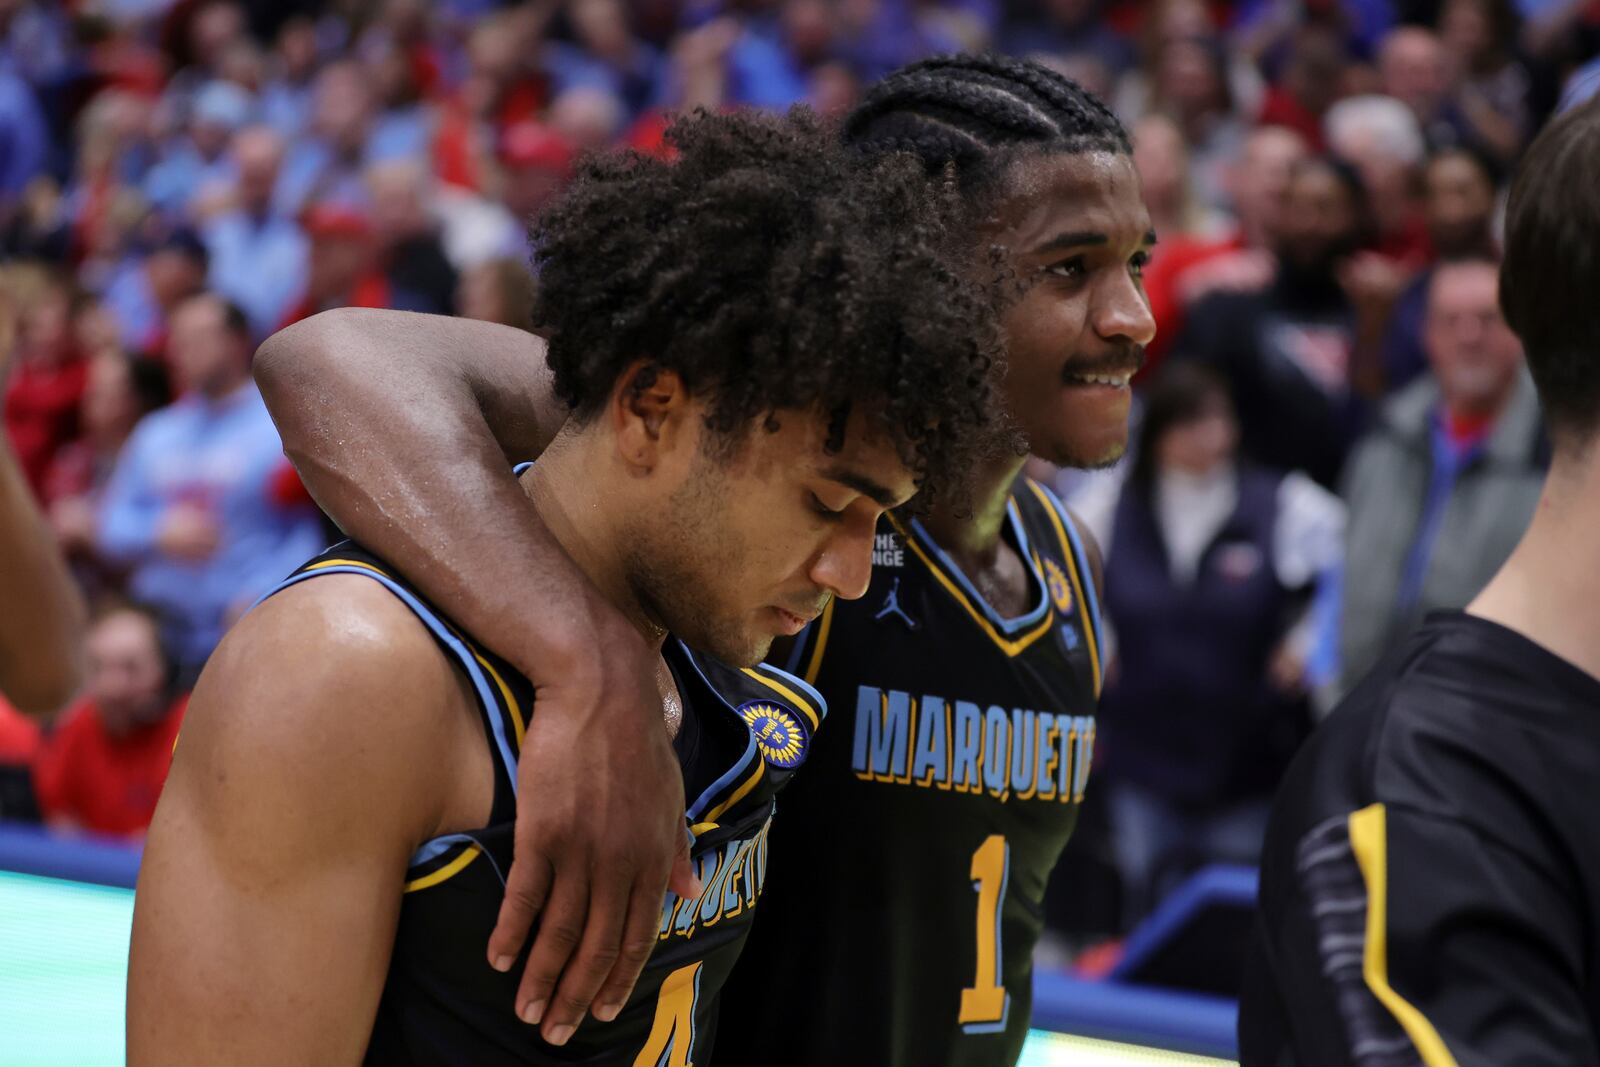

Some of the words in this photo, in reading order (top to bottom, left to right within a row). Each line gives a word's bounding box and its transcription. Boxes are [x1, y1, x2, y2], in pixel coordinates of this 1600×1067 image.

[874, 533, 899, 550] HE
[756, 718, 778, 740] Lovell
[772, 731, 785, 744] 24
[958, 834, 1011, 1034] 1
